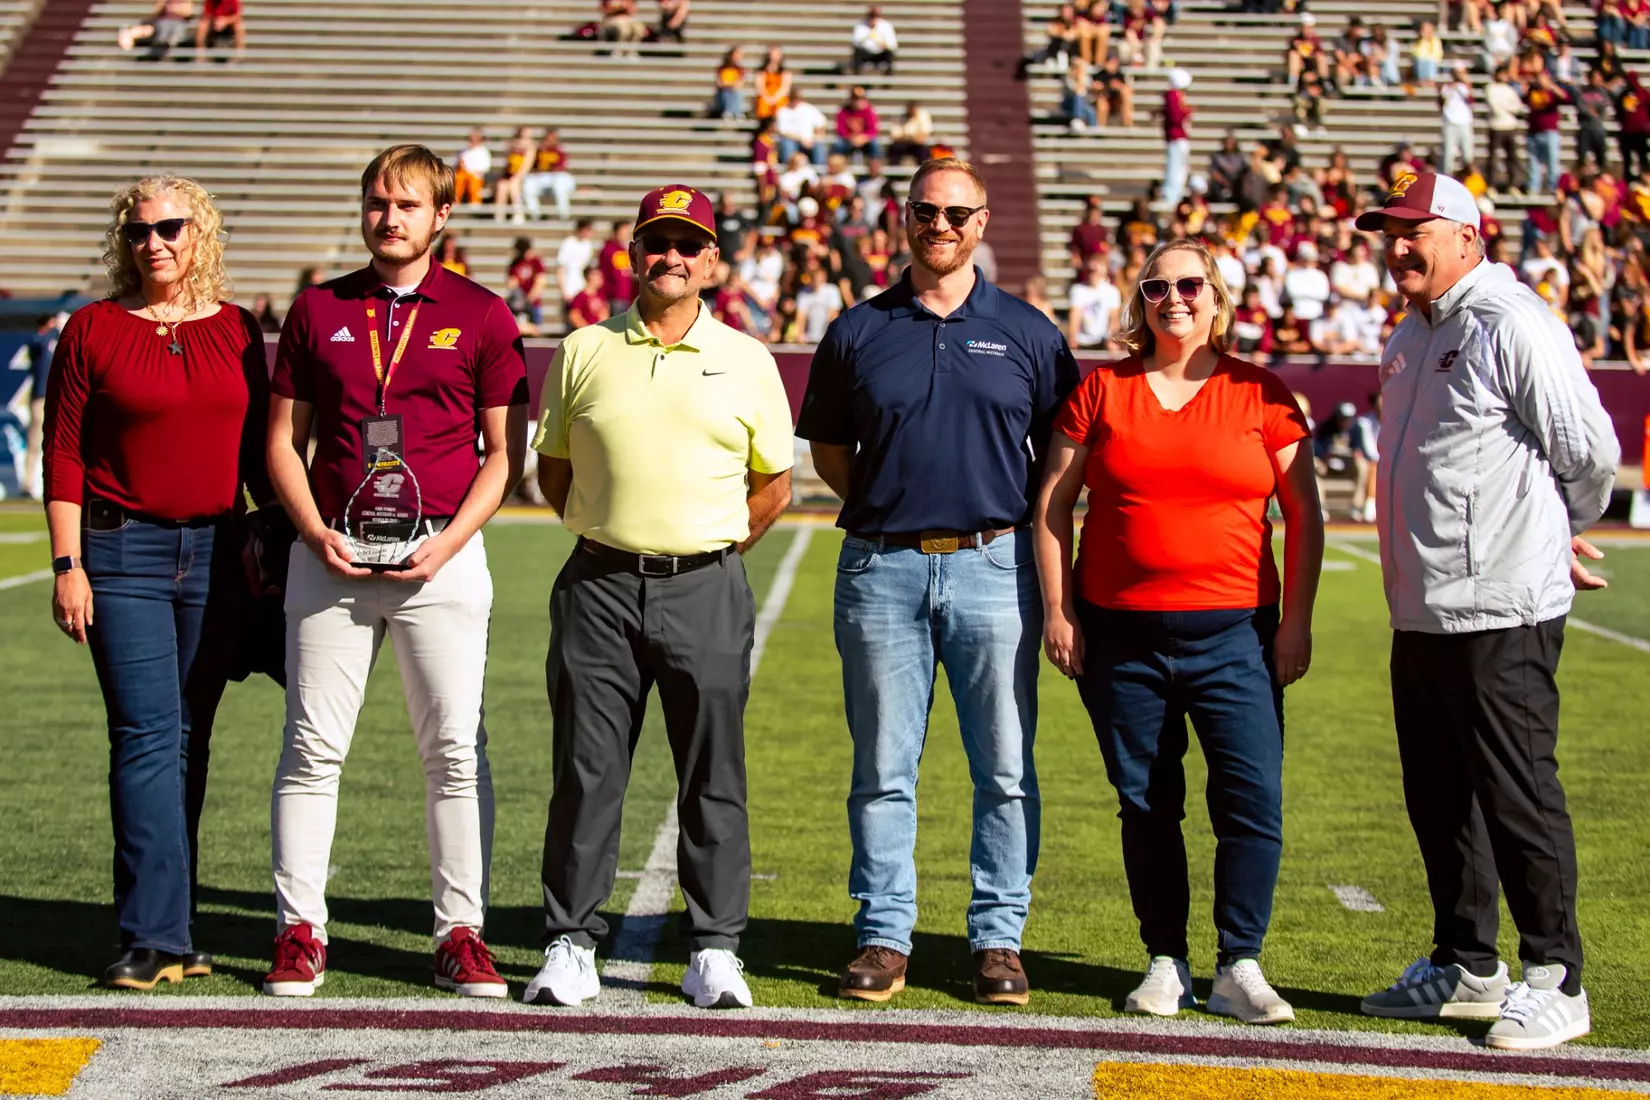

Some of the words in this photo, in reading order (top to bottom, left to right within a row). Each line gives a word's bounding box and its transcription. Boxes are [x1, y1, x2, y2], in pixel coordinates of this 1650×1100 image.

[977, 341, 1006, 351] McLaren
[376, 535, 400, 543] McLaren
[219, 1057, 975, 1100] 1946
